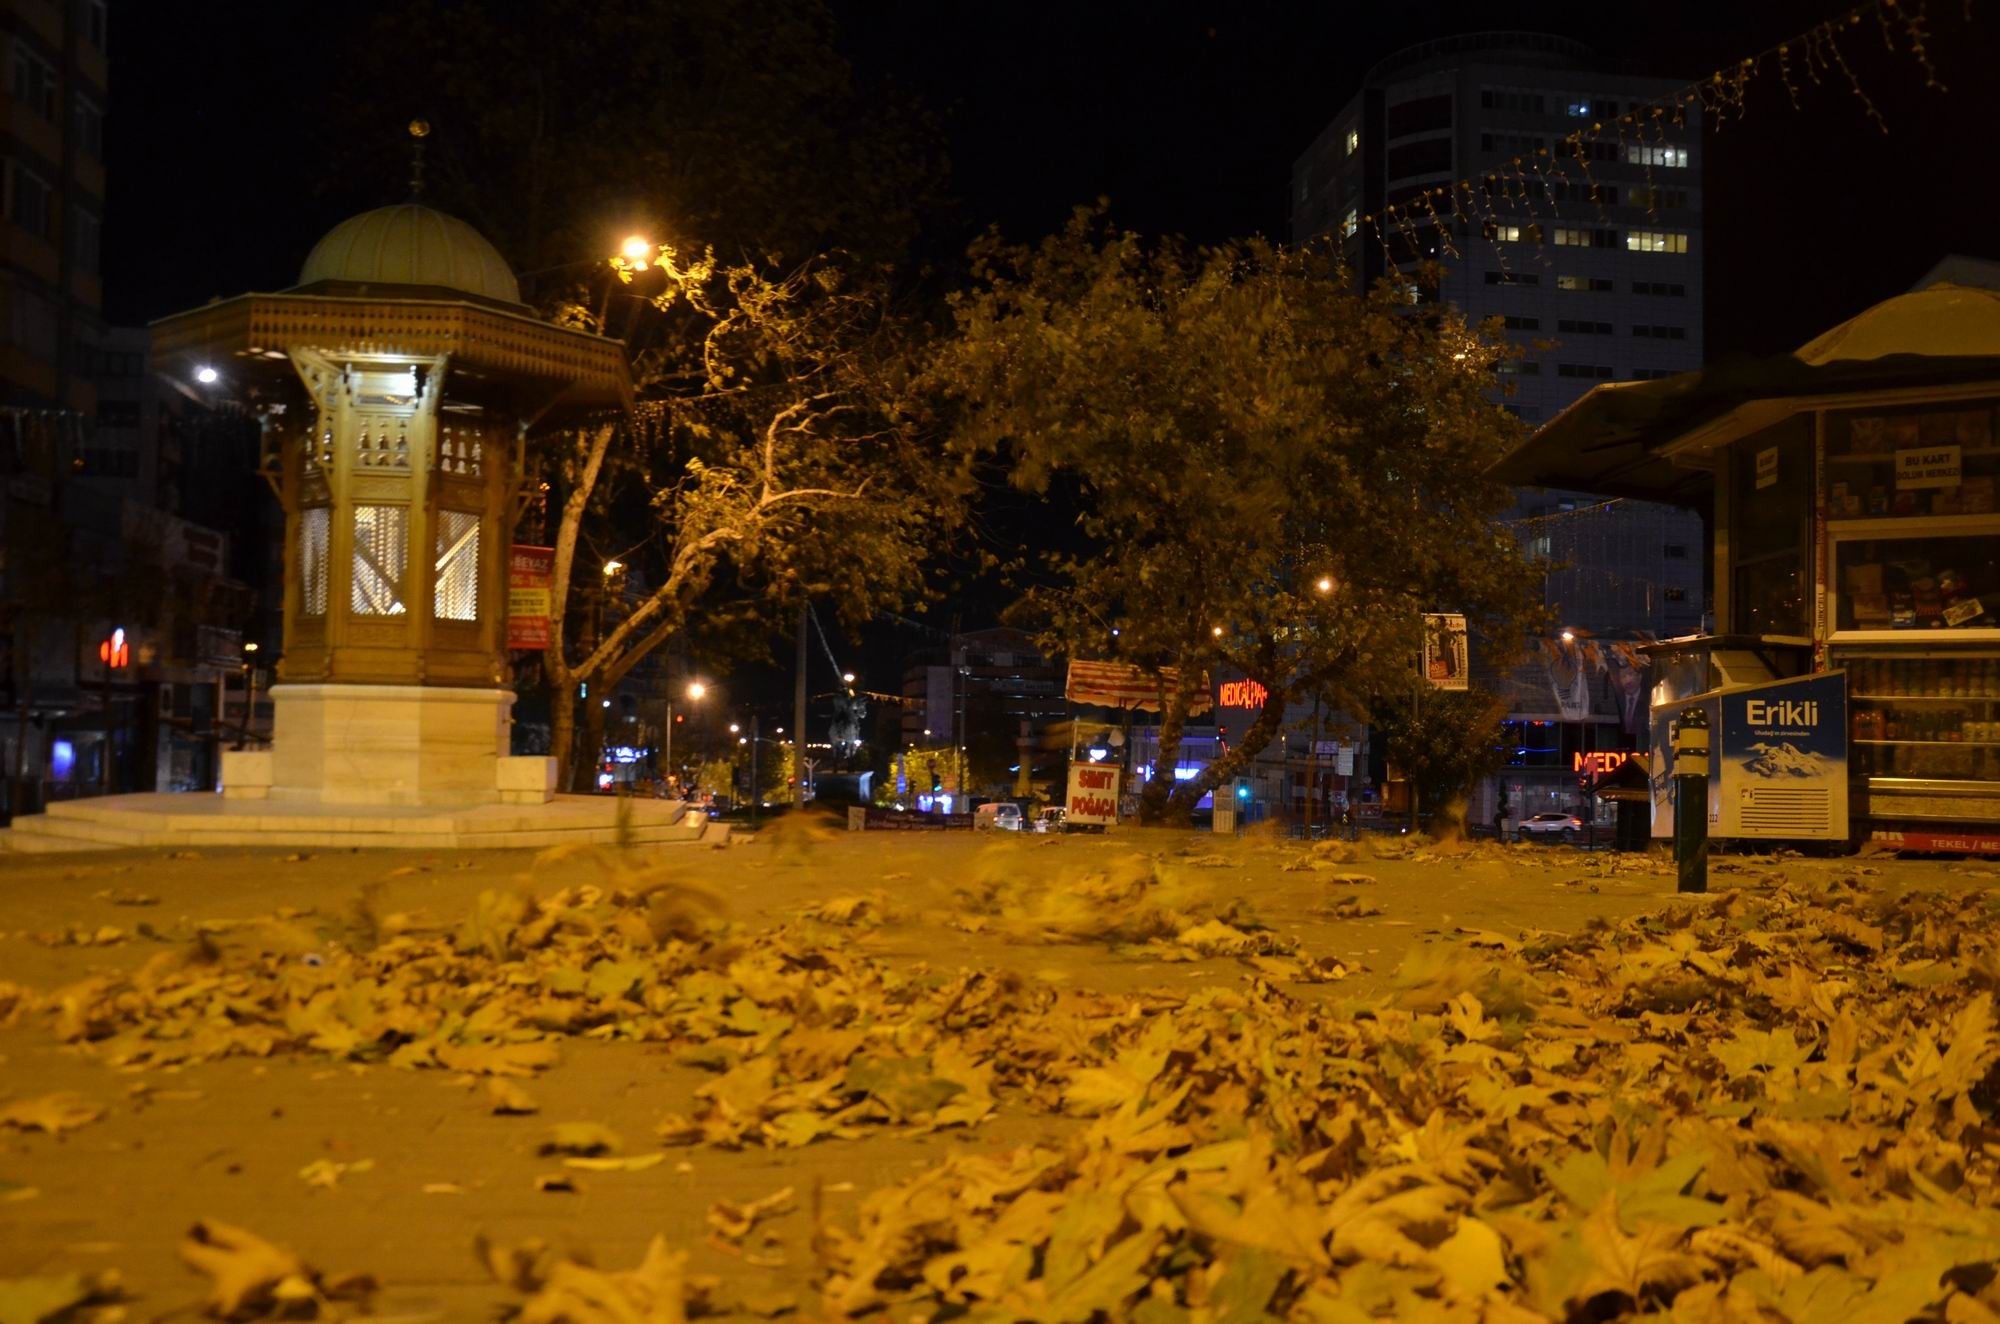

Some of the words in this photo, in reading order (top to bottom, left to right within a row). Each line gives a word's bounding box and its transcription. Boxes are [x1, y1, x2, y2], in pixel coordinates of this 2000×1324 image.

[1922, 452, 1952, 465] KART
[1746, 699, 1818, 727] Erikli
[1071, 792, 1116, 822] POĞAÇA
[1930, 839, 1970, 850] TEKEL
